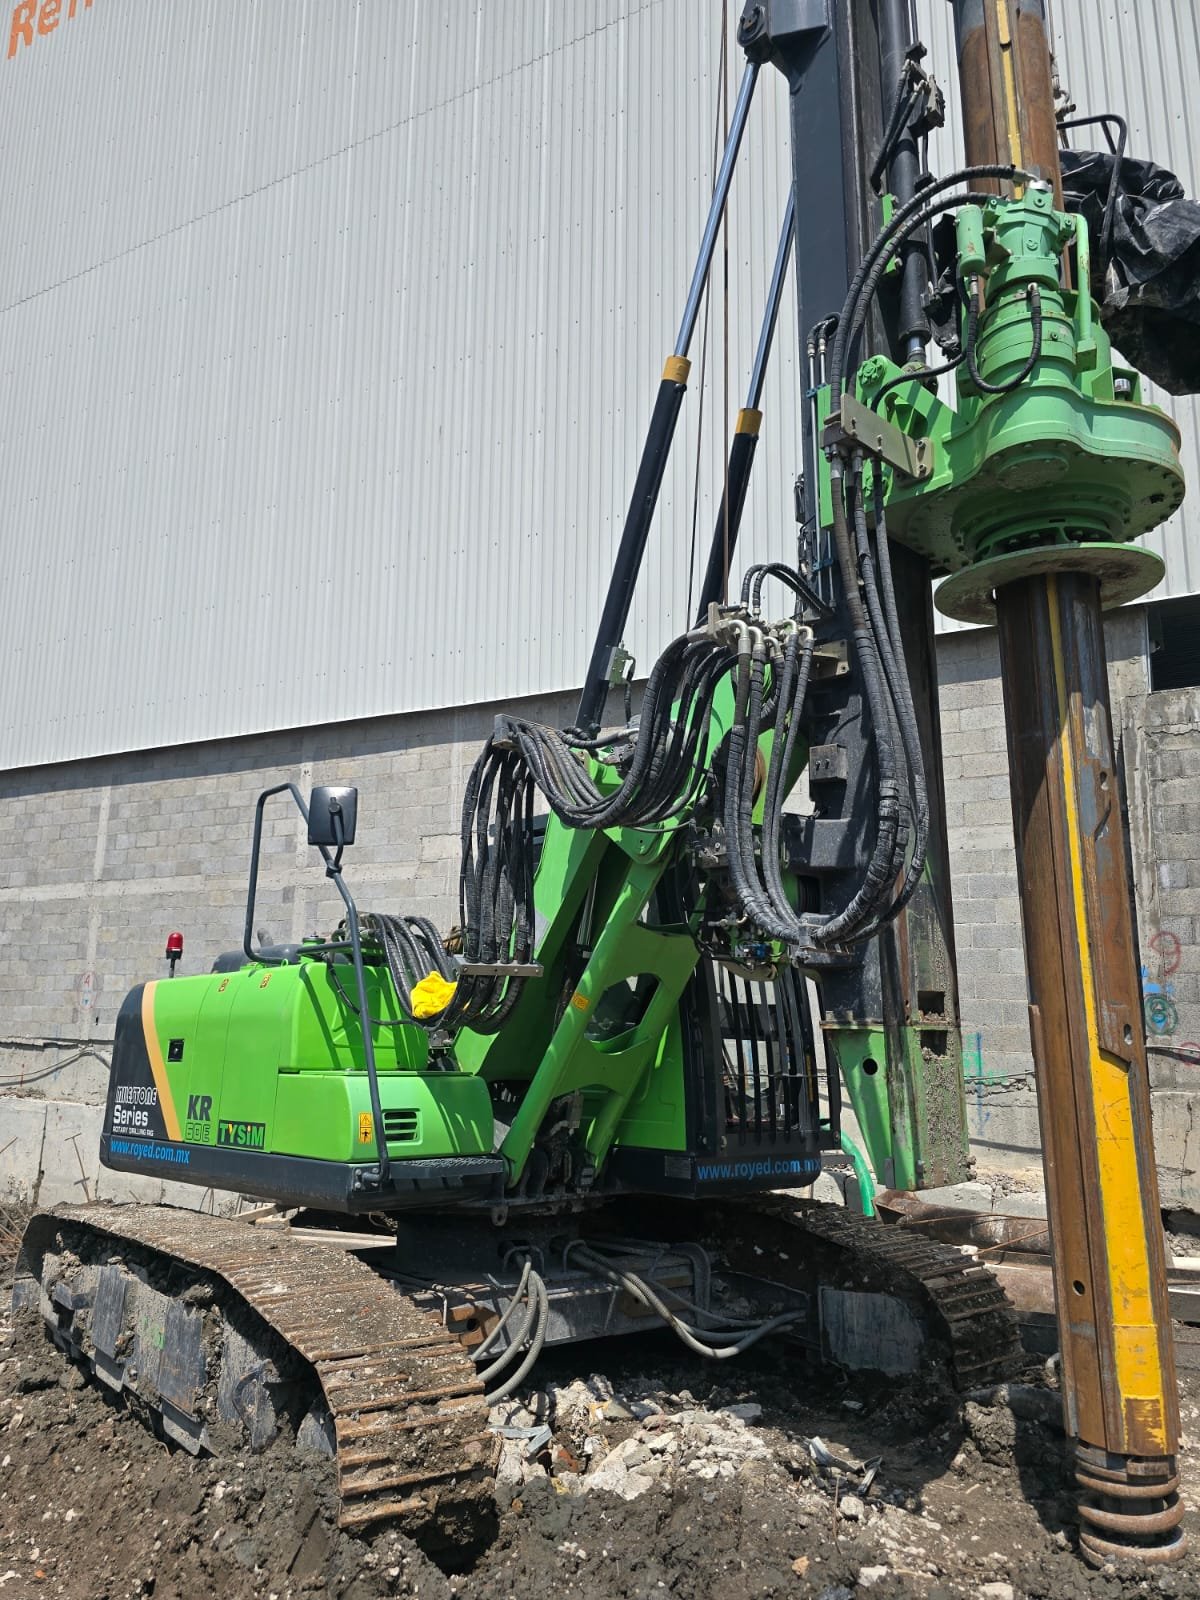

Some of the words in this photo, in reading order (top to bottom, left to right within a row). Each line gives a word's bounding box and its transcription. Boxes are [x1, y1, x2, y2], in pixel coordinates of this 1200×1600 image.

[113, 1104, 149, 1127] Series
[187, 1095, 212, 1121] KR
[111, 1140, 189, 1163] www.royed.com.mx
[697, 1157, 820, 1180] www.royed.com.mx
